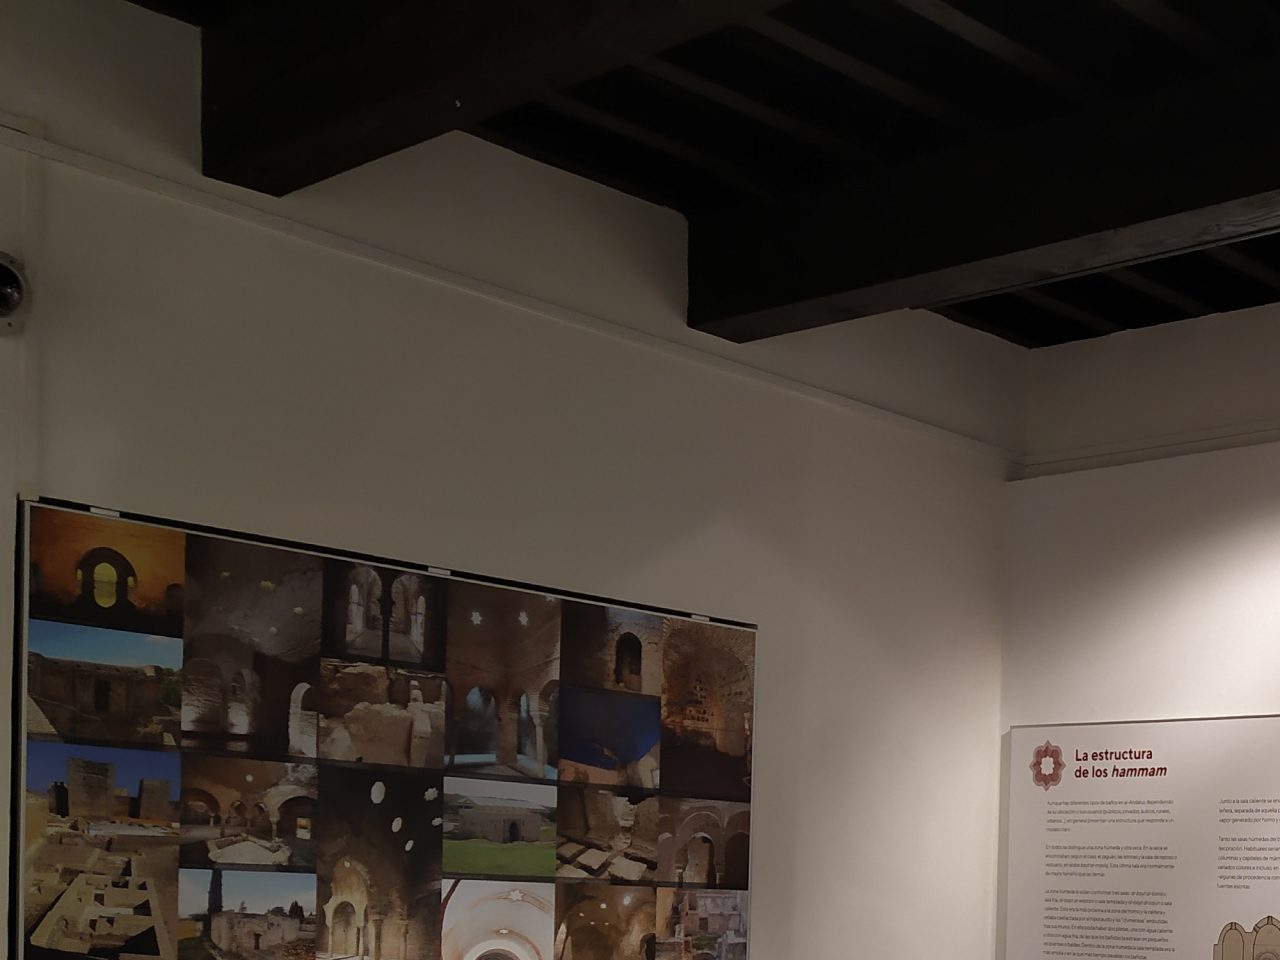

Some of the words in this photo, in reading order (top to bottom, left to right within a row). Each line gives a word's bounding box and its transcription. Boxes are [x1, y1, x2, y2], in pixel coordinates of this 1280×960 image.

[1075, 749, 1088, 761] La
[1091, 749, 1153, 760] estructura
[1074, 766, 1089, 778] de
[1092, 766, 1108, 778] los
[1112, 765, 1168, 777] hammam
